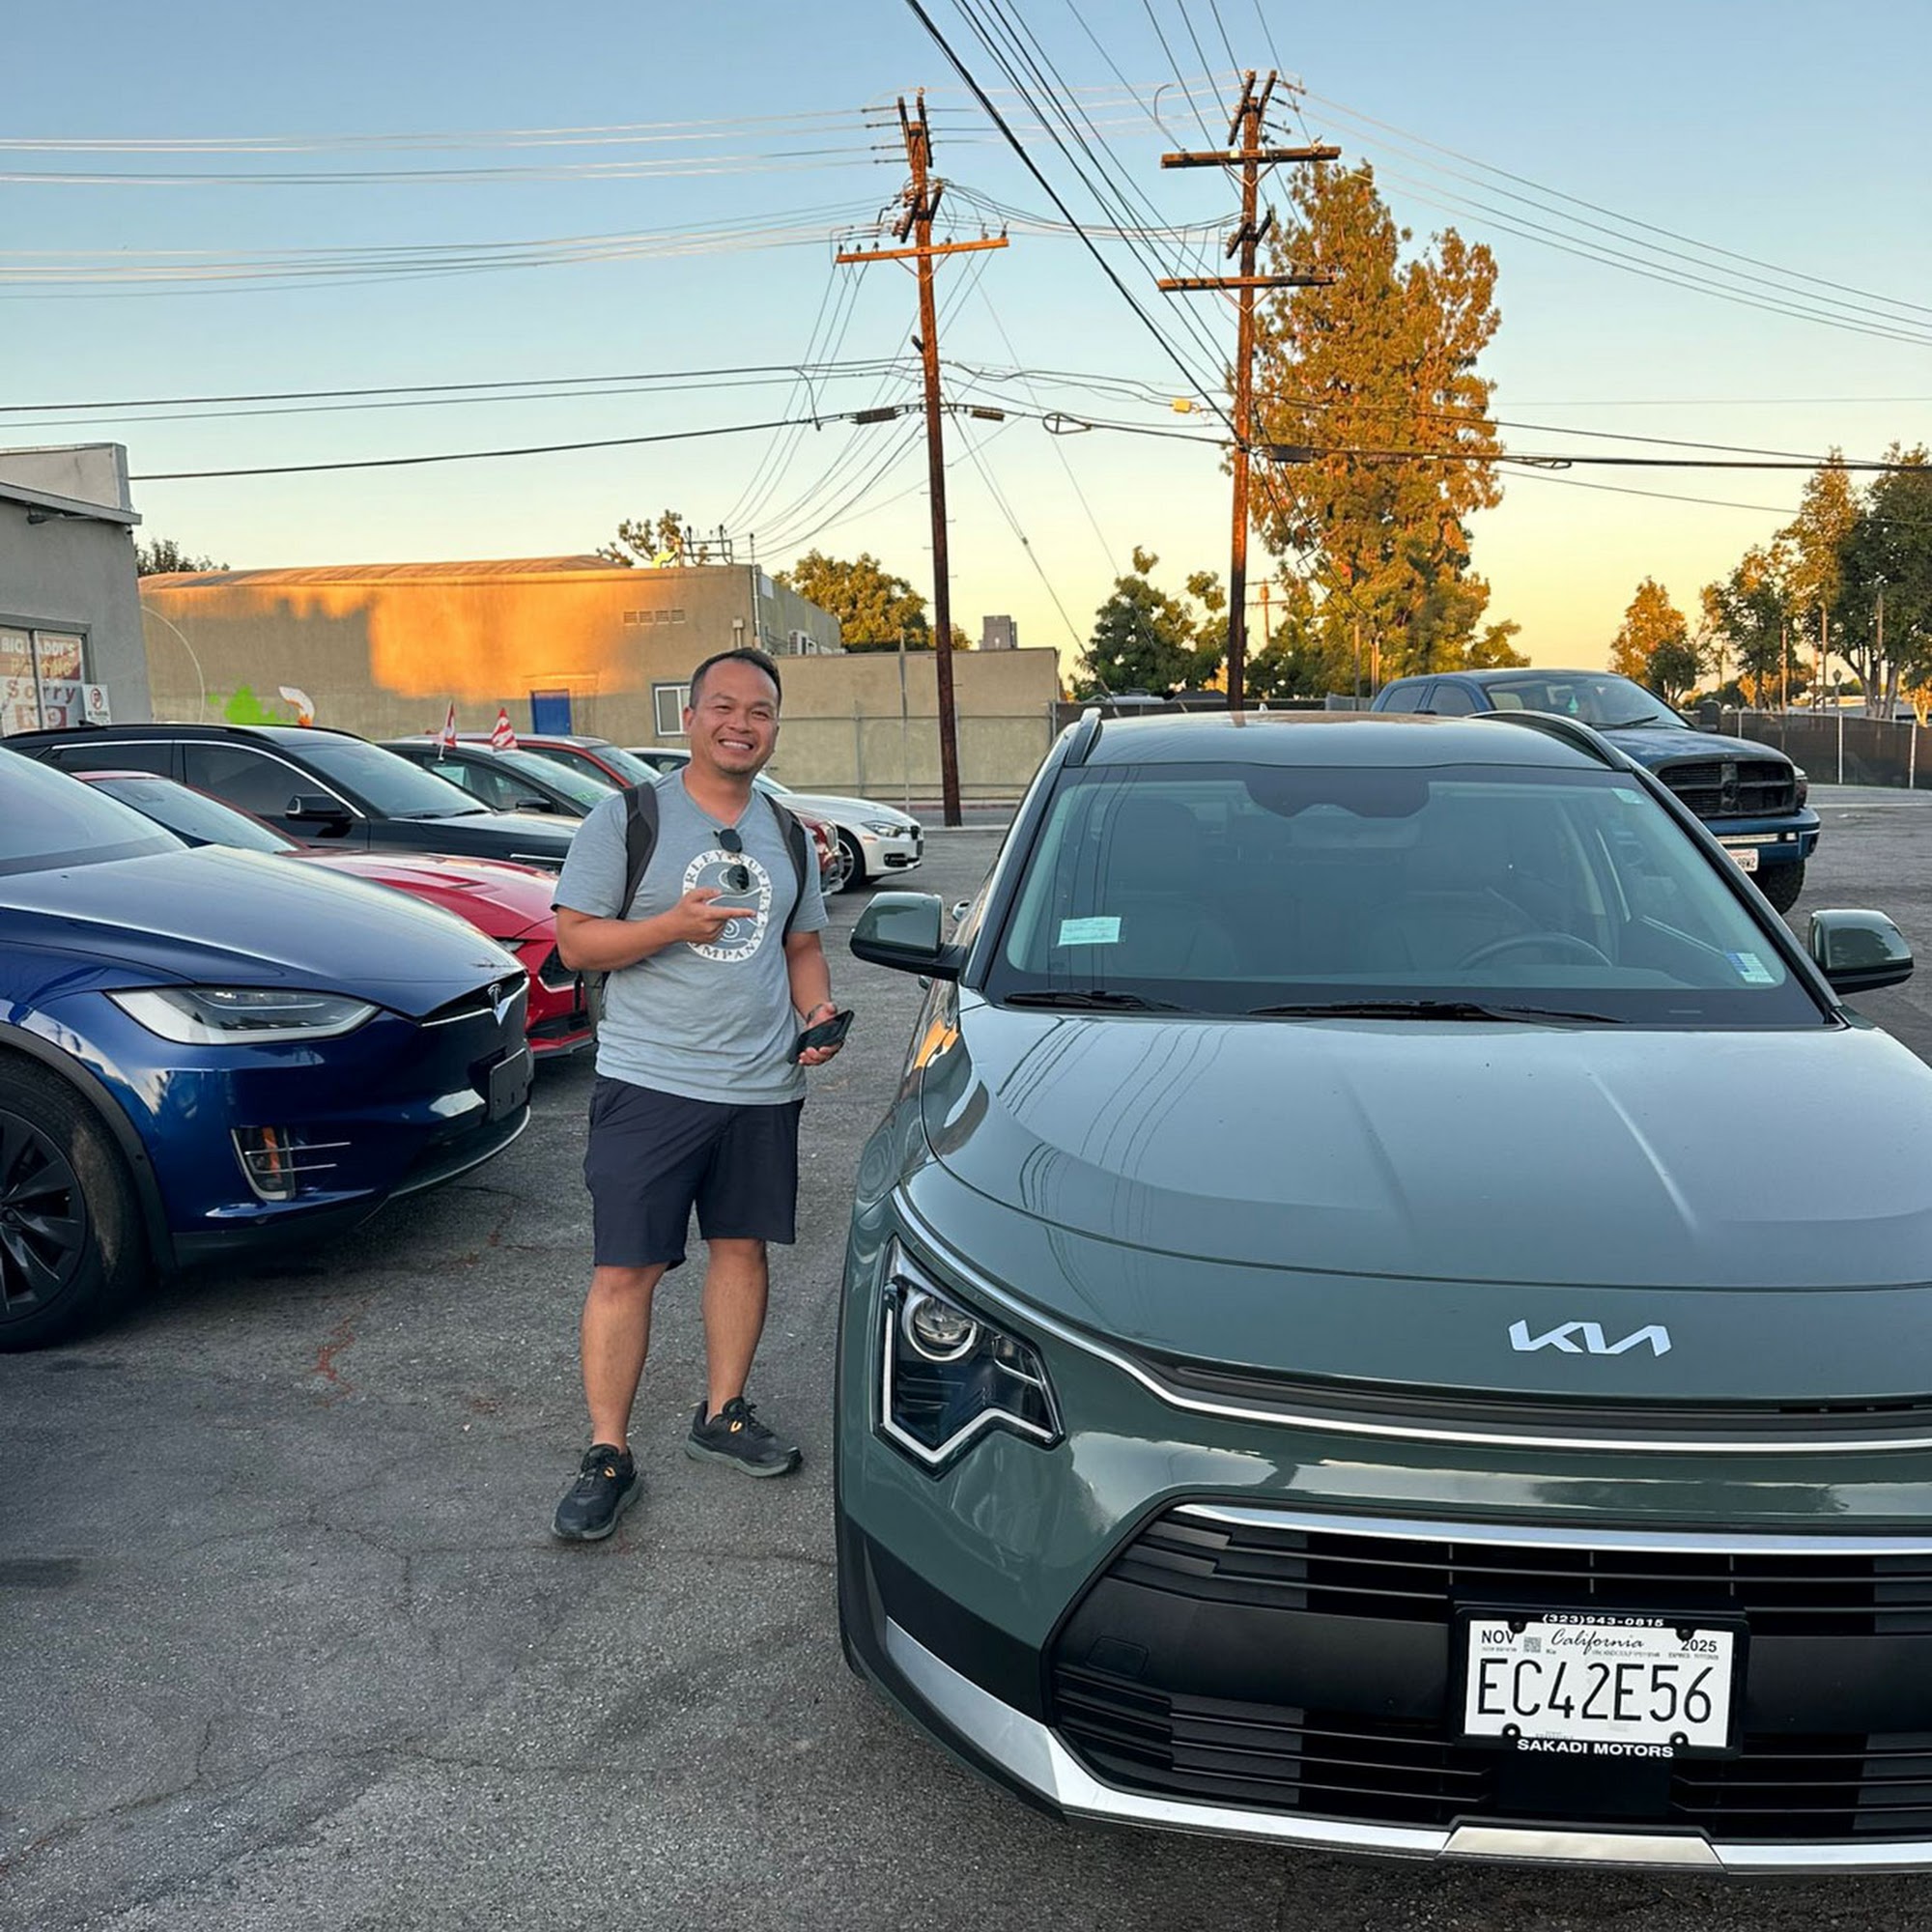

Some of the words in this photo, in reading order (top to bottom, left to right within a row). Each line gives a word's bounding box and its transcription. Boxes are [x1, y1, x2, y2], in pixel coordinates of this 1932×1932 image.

[7, 679, 75, 704] Sorry
[684, 850, 724, 893] RLEY
[694, 933, 761, 959] MPANY
[1542, 1613, 1664, 1628] (323)943-0815
[1481, 1630, 1516, 1644] NOV
[1550, 1628, 1644, 1656] California
[1681, 1638, 1718, 1653] 2025
[1478, 1658, 1714, 1723] EC42E56
[1517, 1739, 1588, 1754] SAKADI
[1594, 1743, 1674, 1758] MOTORS
